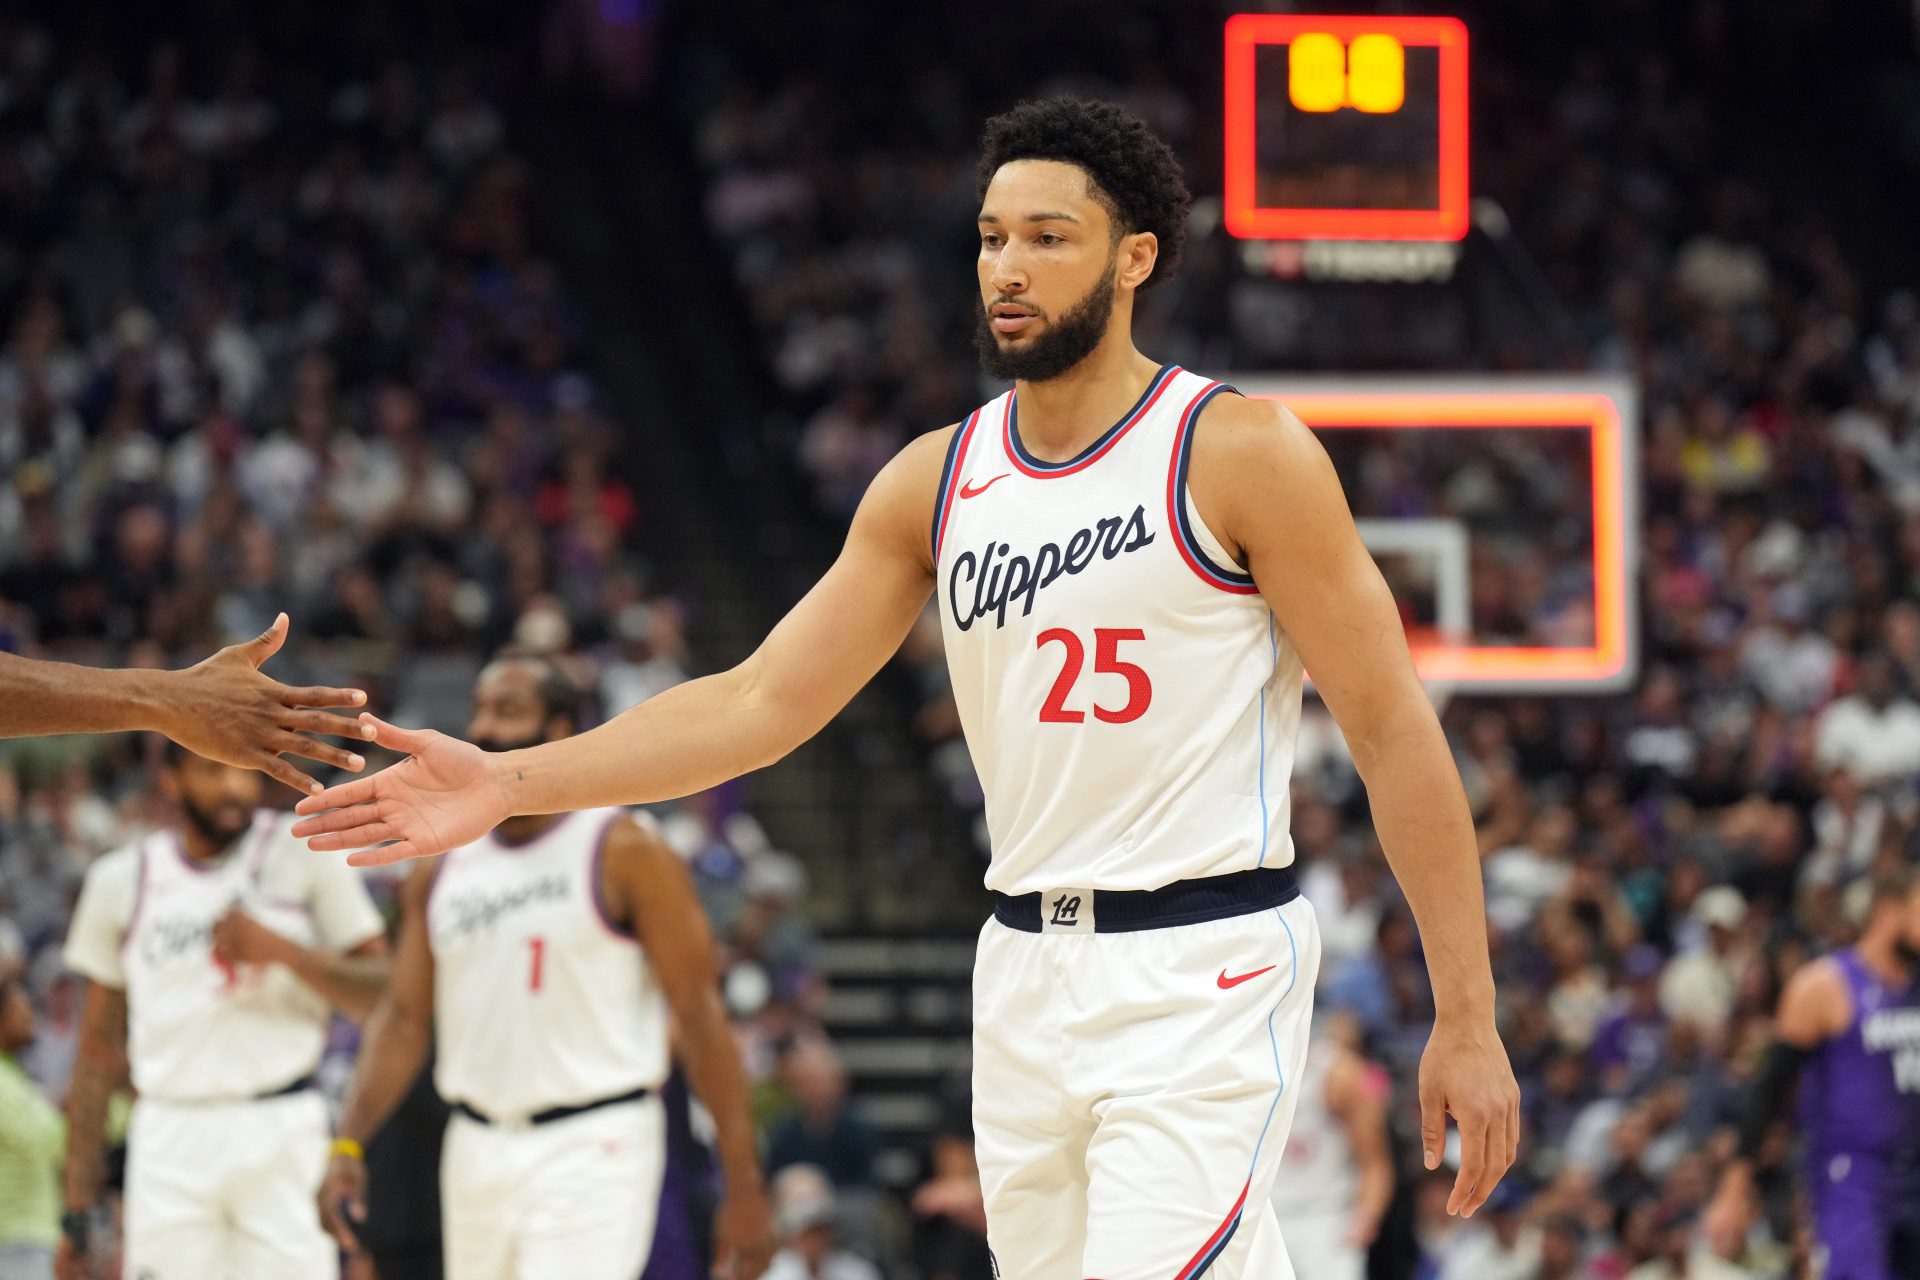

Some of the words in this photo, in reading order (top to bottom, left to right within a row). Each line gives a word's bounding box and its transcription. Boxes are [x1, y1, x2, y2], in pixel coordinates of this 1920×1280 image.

[949, 504, 1156, 632] Clippers
[1036, 627, 1153, 724] 25
[1050, 893, 1082, 926] LA
[527, 935, 547, 993] 1
